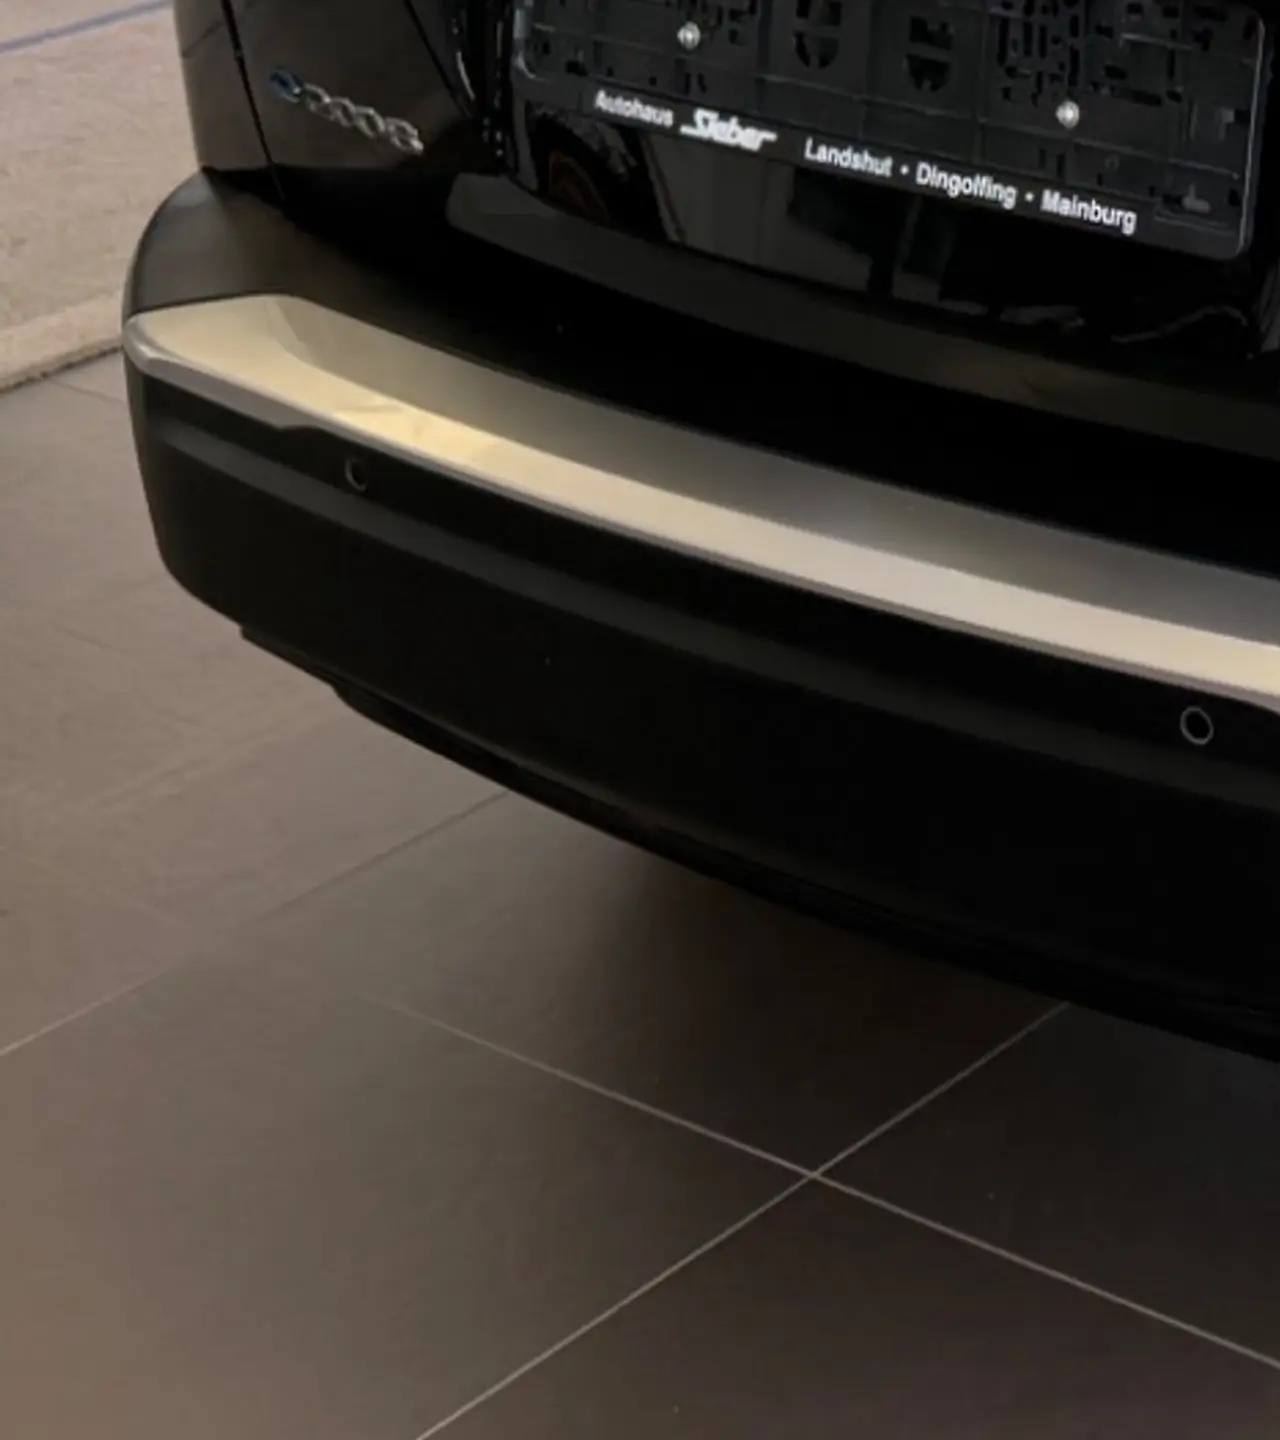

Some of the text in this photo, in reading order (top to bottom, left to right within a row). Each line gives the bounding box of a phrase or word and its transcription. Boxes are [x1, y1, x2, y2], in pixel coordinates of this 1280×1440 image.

[594, 88, 1139, 237] Autohaus Sieber Landshut Dingolfing Mainburg
